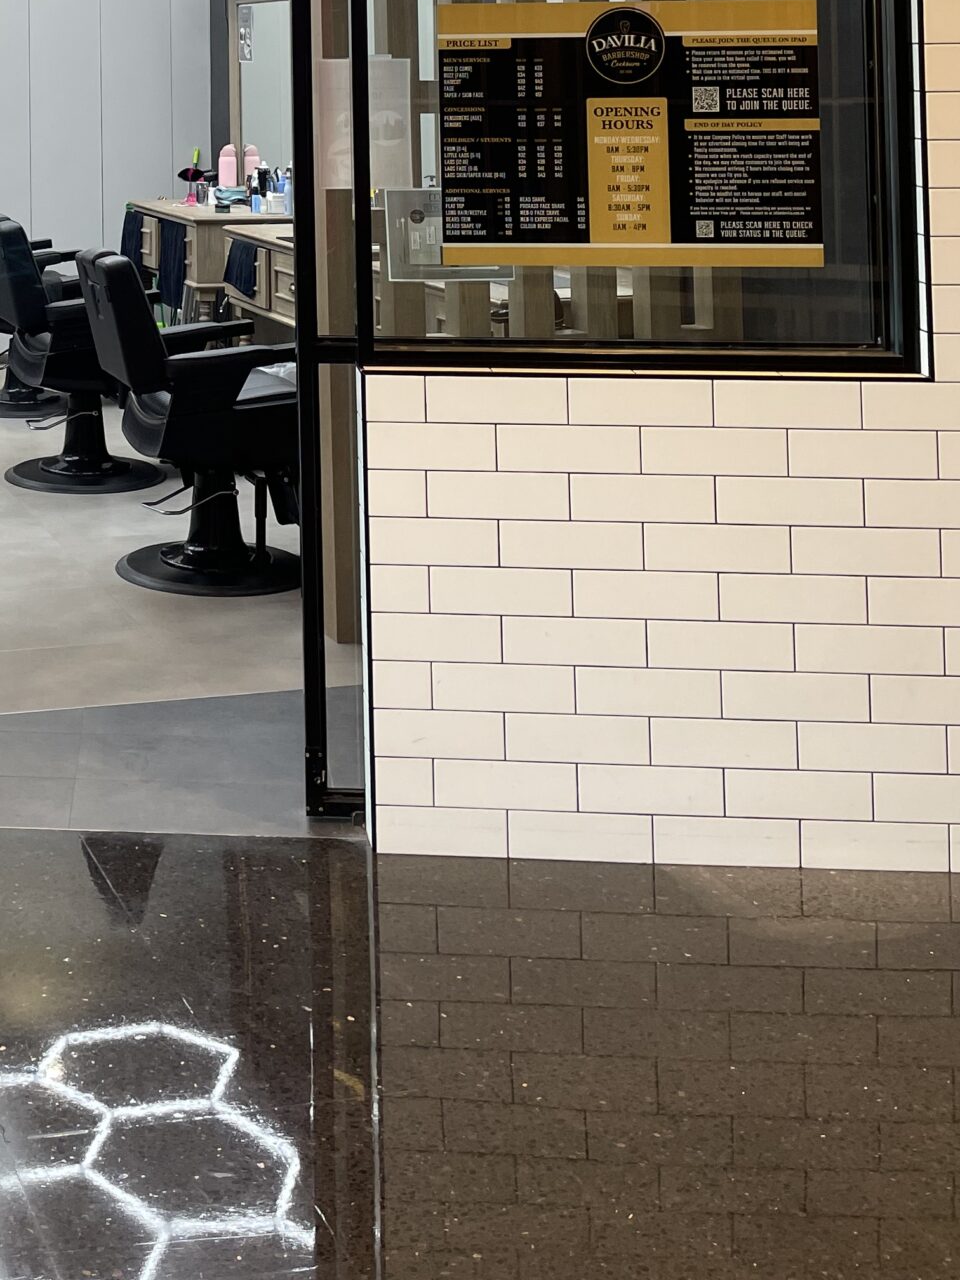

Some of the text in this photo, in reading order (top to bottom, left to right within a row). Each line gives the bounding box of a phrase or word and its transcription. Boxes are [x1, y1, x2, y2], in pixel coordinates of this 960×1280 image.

[592, 35, 657, 52] DAVILIA
[602, 51, 650, 61] BARBERSHOP
[726, 88, 810, 98] PLEASE SCAN HERE
[726, 100, 812, 111] TO JOIN THE QUEUE.
[594, 107, 661, 117] OPENING
[602, 120, 653, 130] HOURS
[720, 221, 743, 229] PLEASE
[746, 221, 762, 229] SCAN
[764, 221, 781, 229] HERE
[786, 229, 808, 238] QUEUE.
